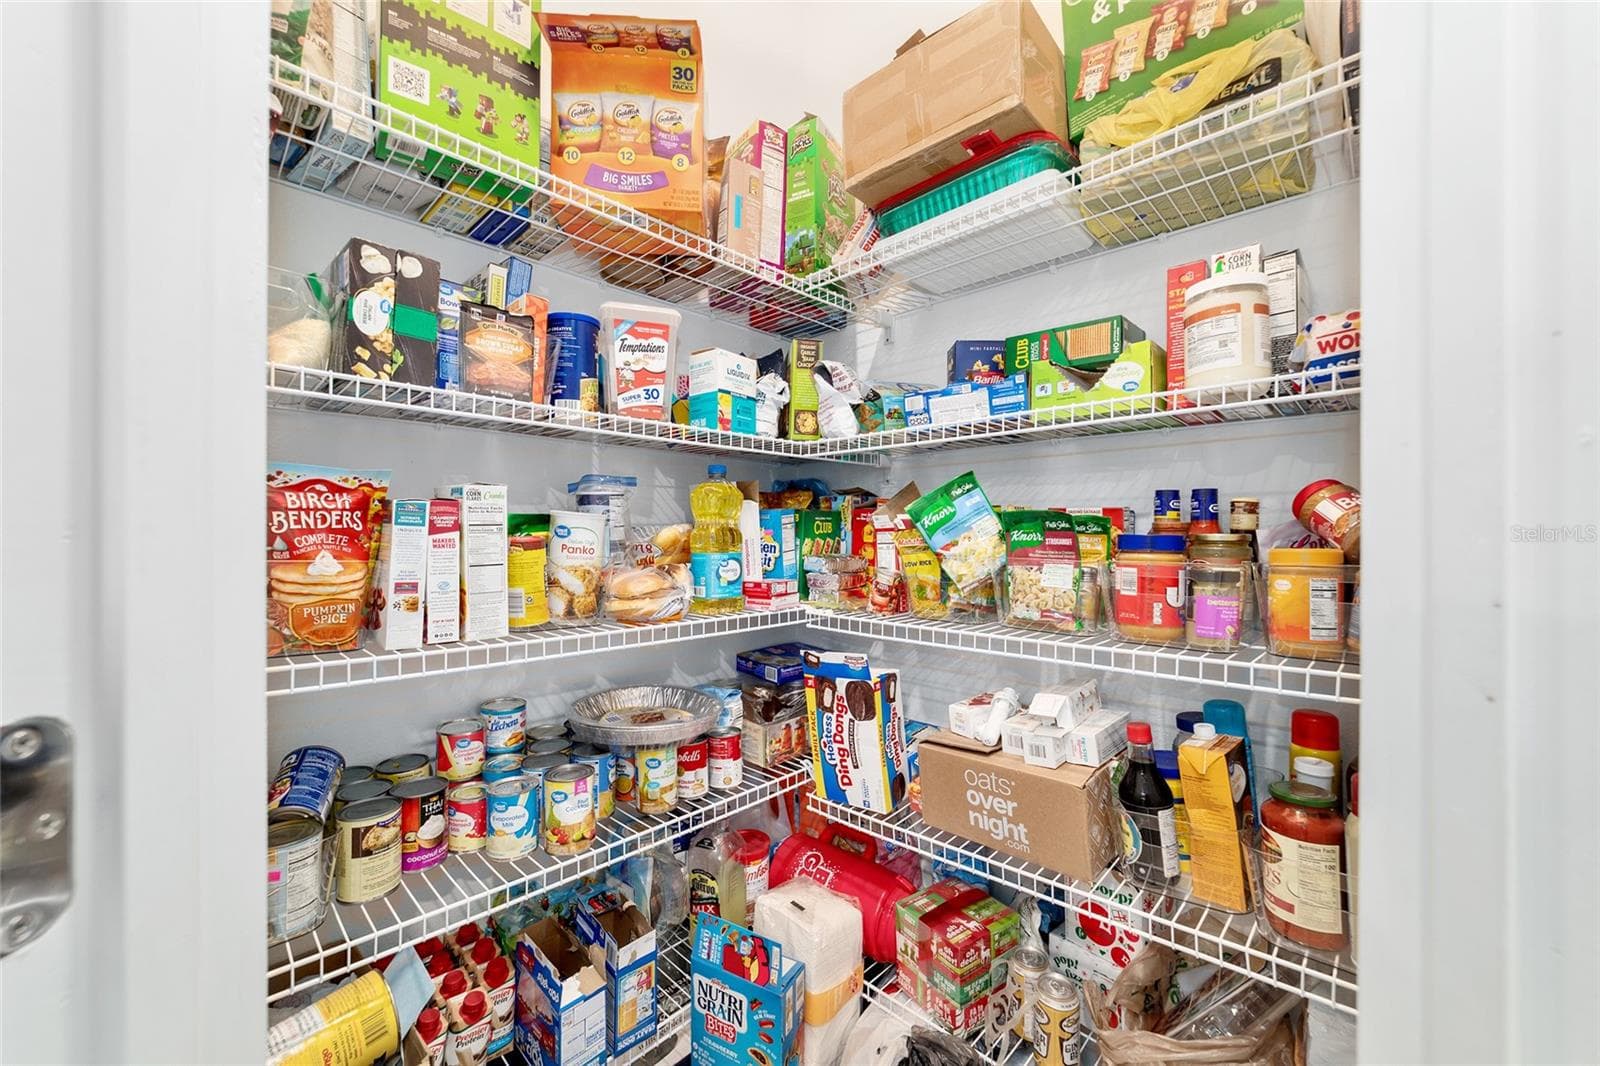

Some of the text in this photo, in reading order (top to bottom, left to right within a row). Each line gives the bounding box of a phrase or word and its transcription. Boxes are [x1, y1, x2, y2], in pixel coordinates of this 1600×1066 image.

[672, 66, 694, 81] 30
[571, 105, 596, 118] Goldfish
[615, 105, 641, 119] Goldfish
[657, 113, 683, 124] Goldfish
[565, 150, 579, 160] 10
[620, 150, 633, 161] 12
[677, 157, 685, 167] 8
[602, 171, 653, 187] BIG SMILES
[1228, 252, 1252, 264] CORN
[1228, 260, 1253, 272] FLAKES
[619, 337, 665, 355] Temptations
[1015, 338, 1029, 369] CLUB
[1041, 338, 1049, 360] Original
[1113, 342, 1120, 354] NO
[643, 388, 660, 401] 30
[284, 491, 352, 510] BIRCH
[270, 511, 363, 534] BENDERS
[921, 504, 956, 529] Knorr
[814, 520, 833, 534] CLUB
[294, 534, 349, 548] COMPLETE
[1010, 529, 1044, 542] Knorr
[561, 543, 596, 555] Panko
[303, 603, 356, 618] PUMPKIN
[313, 613, 347, 625] SPICE
[833, 695, 849, 745] Dongs
[825, 715, 836, 761] Hostess
[812, 731, 820, 762] FAMILY
[838, 749, 853, 787] Ding
[964, 769, 1011, 797] oats
[422, 799, 443, 813] THAI
[966, 789, 1018, 817] over
[969, 810, 1029, 846] night
[1004, 840, 1030, 853] .com
[407, 849, 438, 863] coconut
[693, 904, 715, 914] MIX
[1054, 956, 1079, 969] pop!
[698, 980, 743, 1011] NUTRI
[697, 996, 743, 1028] GRAIN
[706, 1013, 735, 1039] BITES
[455, 1026, 488, 1042] Premier
[456, 1033, 485, 1048] Protein
